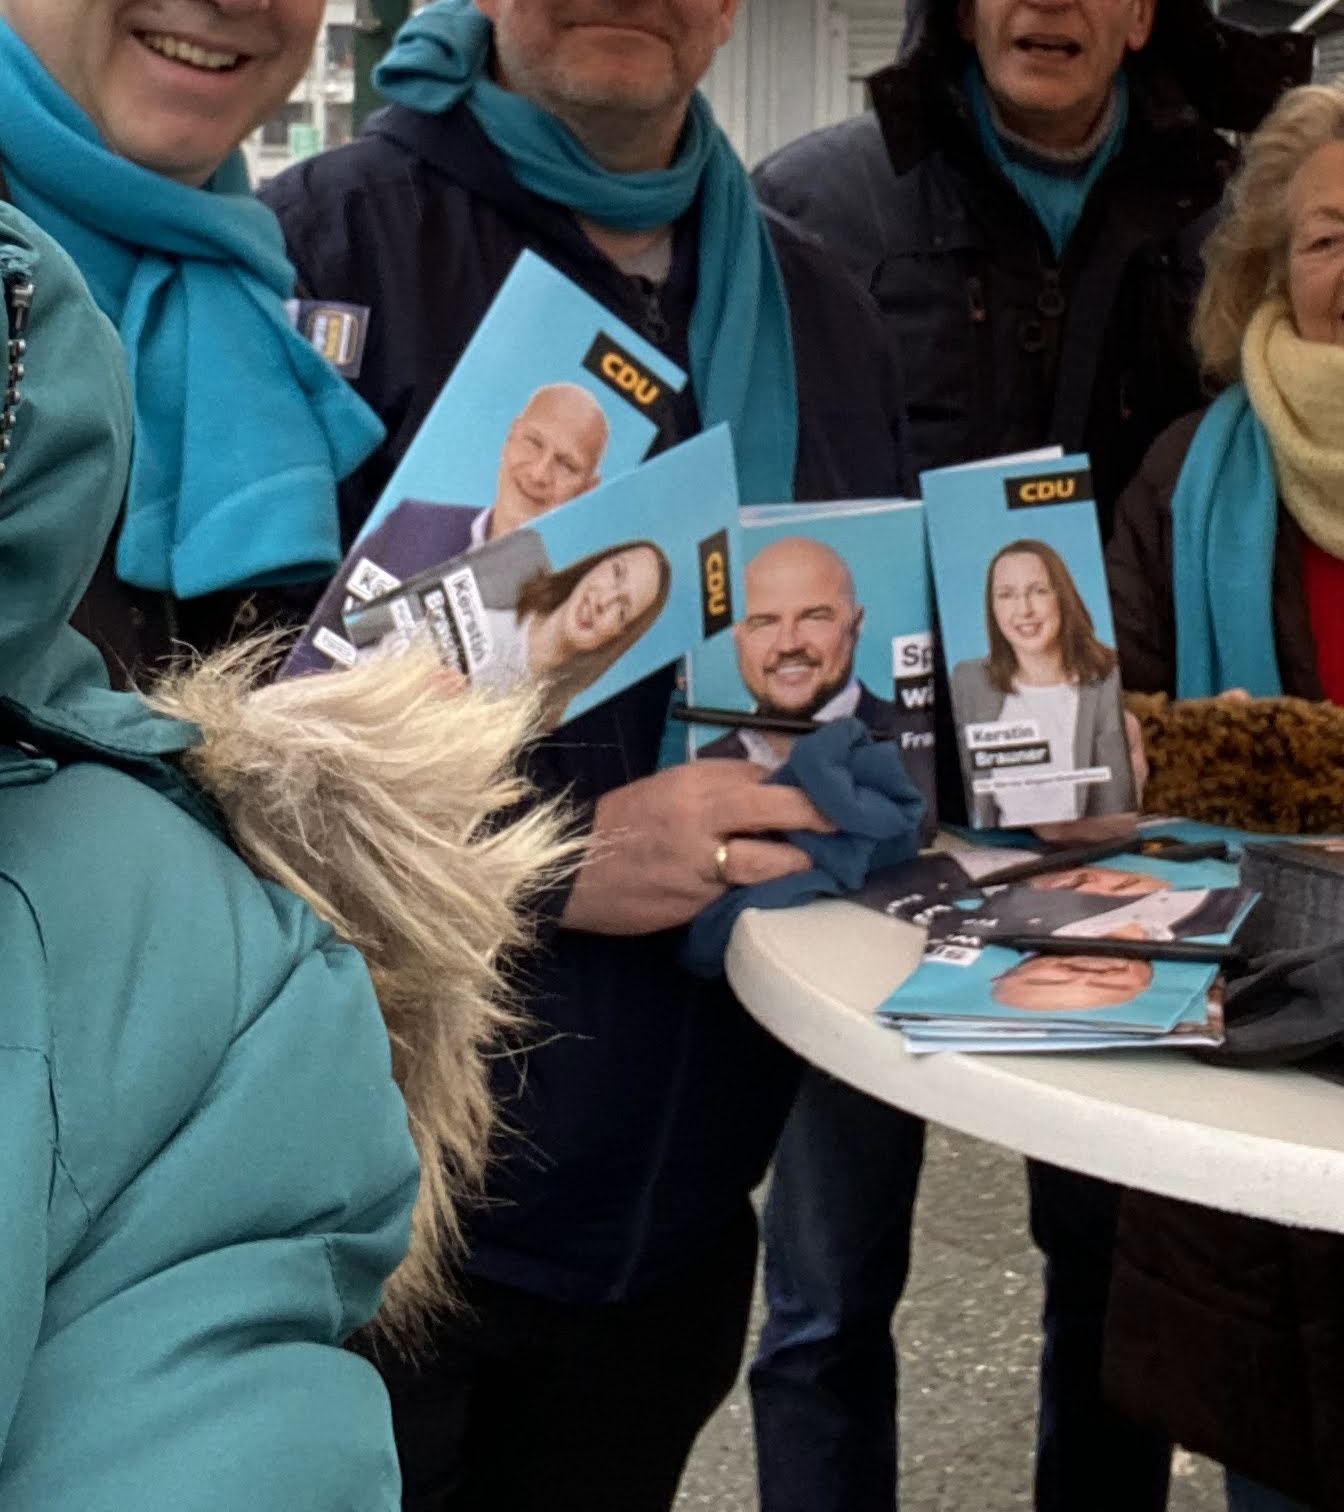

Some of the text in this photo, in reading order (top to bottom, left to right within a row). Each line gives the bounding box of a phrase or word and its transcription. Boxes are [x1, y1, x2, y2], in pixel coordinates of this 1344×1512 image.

[599, 351, 660, 405] CDU
[1019, 476, 1075, 503] CDU
[706, 550, 726, 616] CDU
